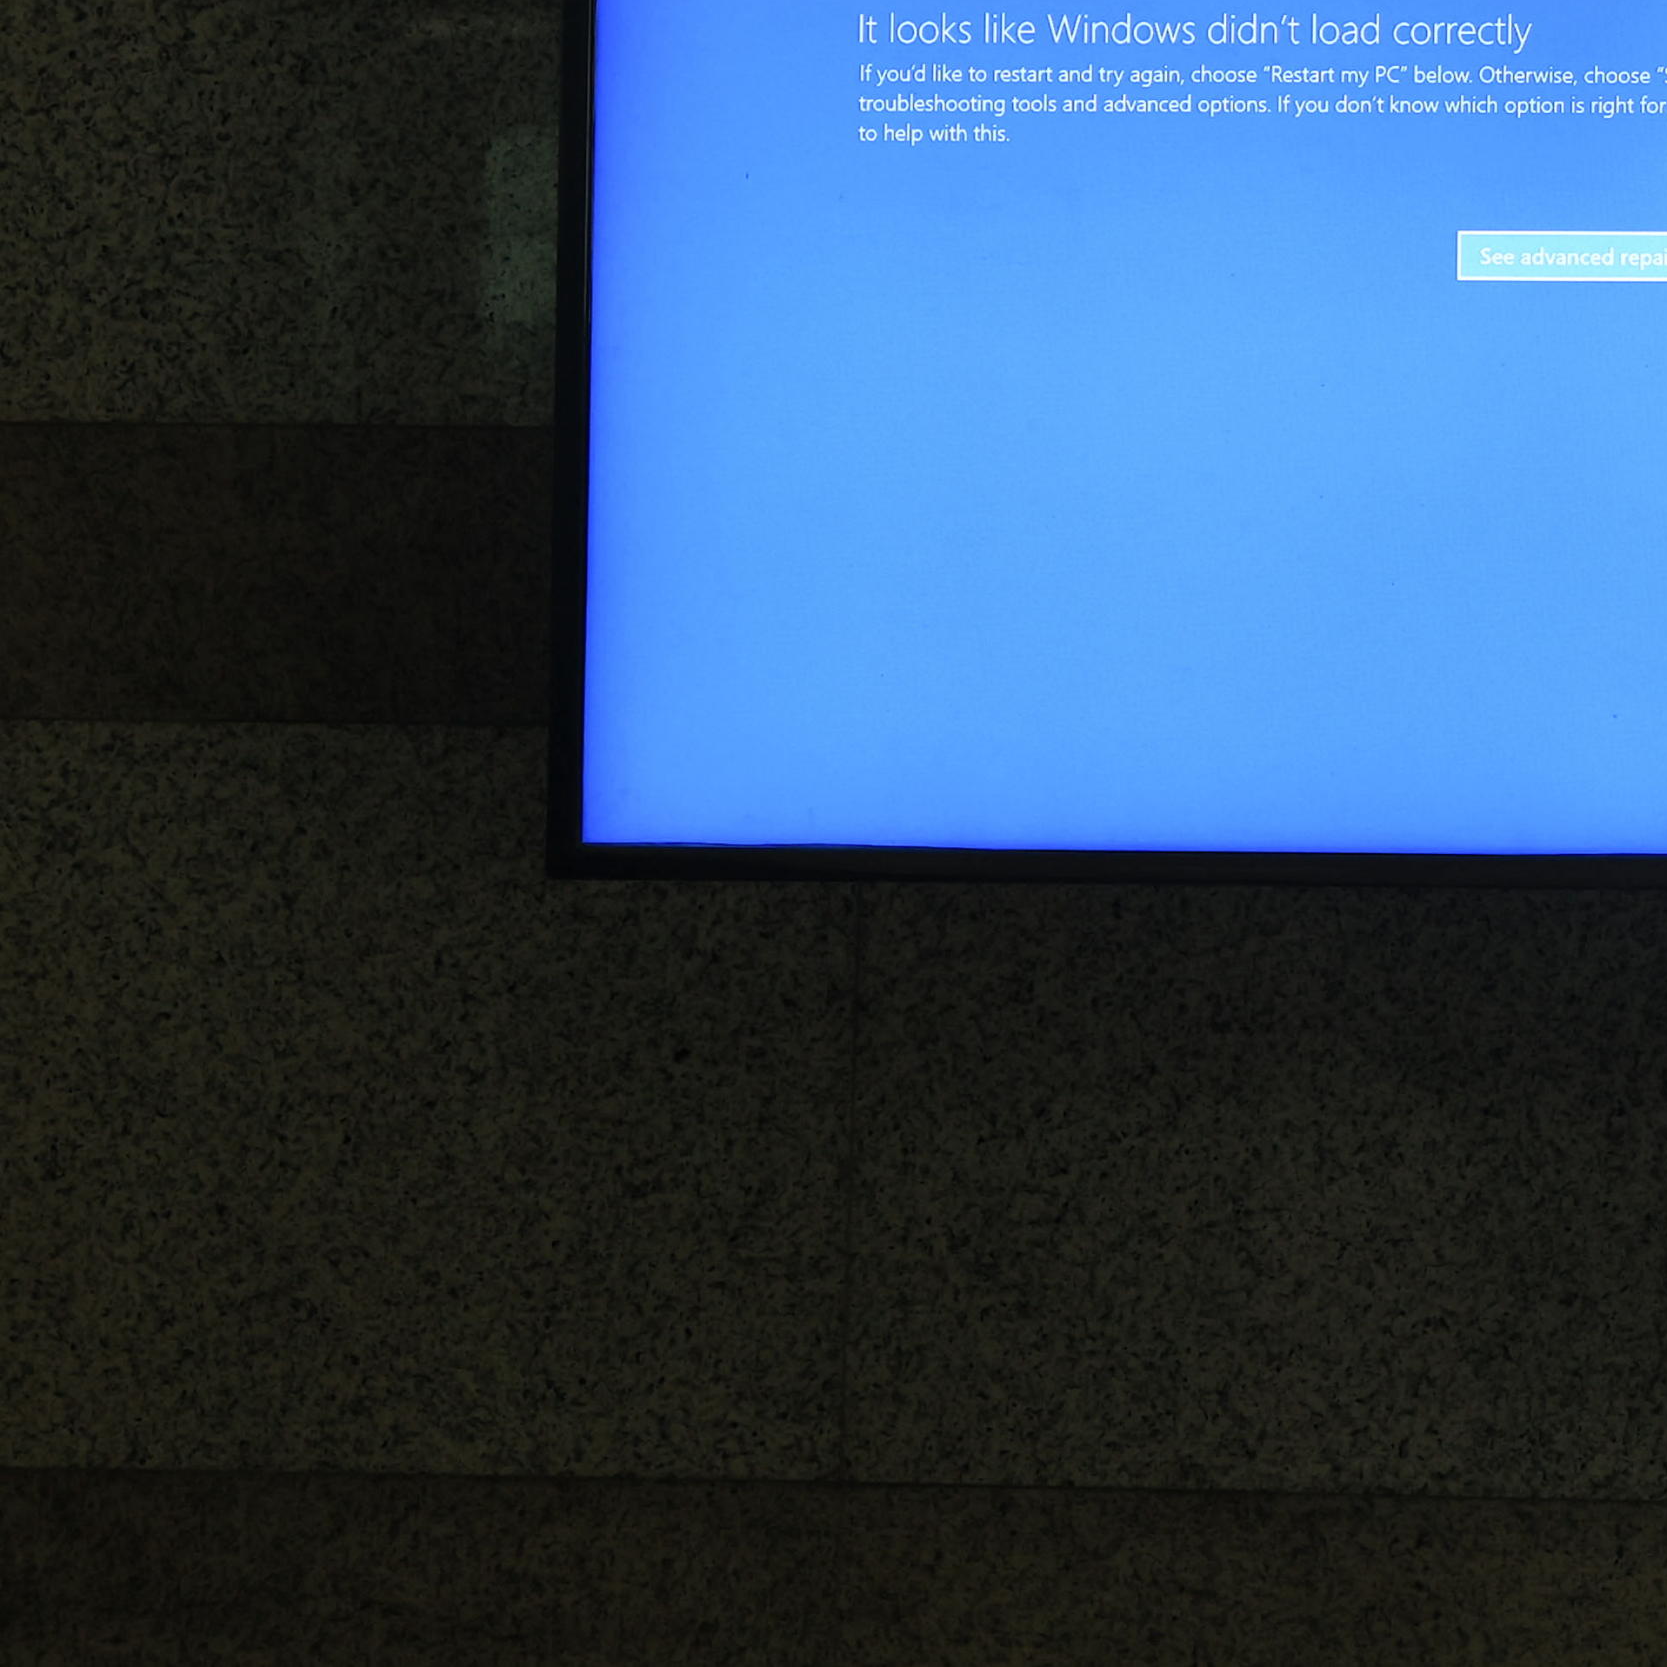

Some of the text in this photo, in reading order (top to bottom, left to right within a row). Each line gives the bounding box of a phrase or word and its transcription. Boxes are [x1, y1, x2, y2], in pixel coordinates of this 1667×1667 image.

[858, 13, 878, 45] It
[890, 11, 972, 45] looks
[984, 12, 1036, 45] like
[1047, 12, 1196, 45] Windows
[1312, 12, 1380, 46] load
[1393, 13, 1533, 55] correctly
